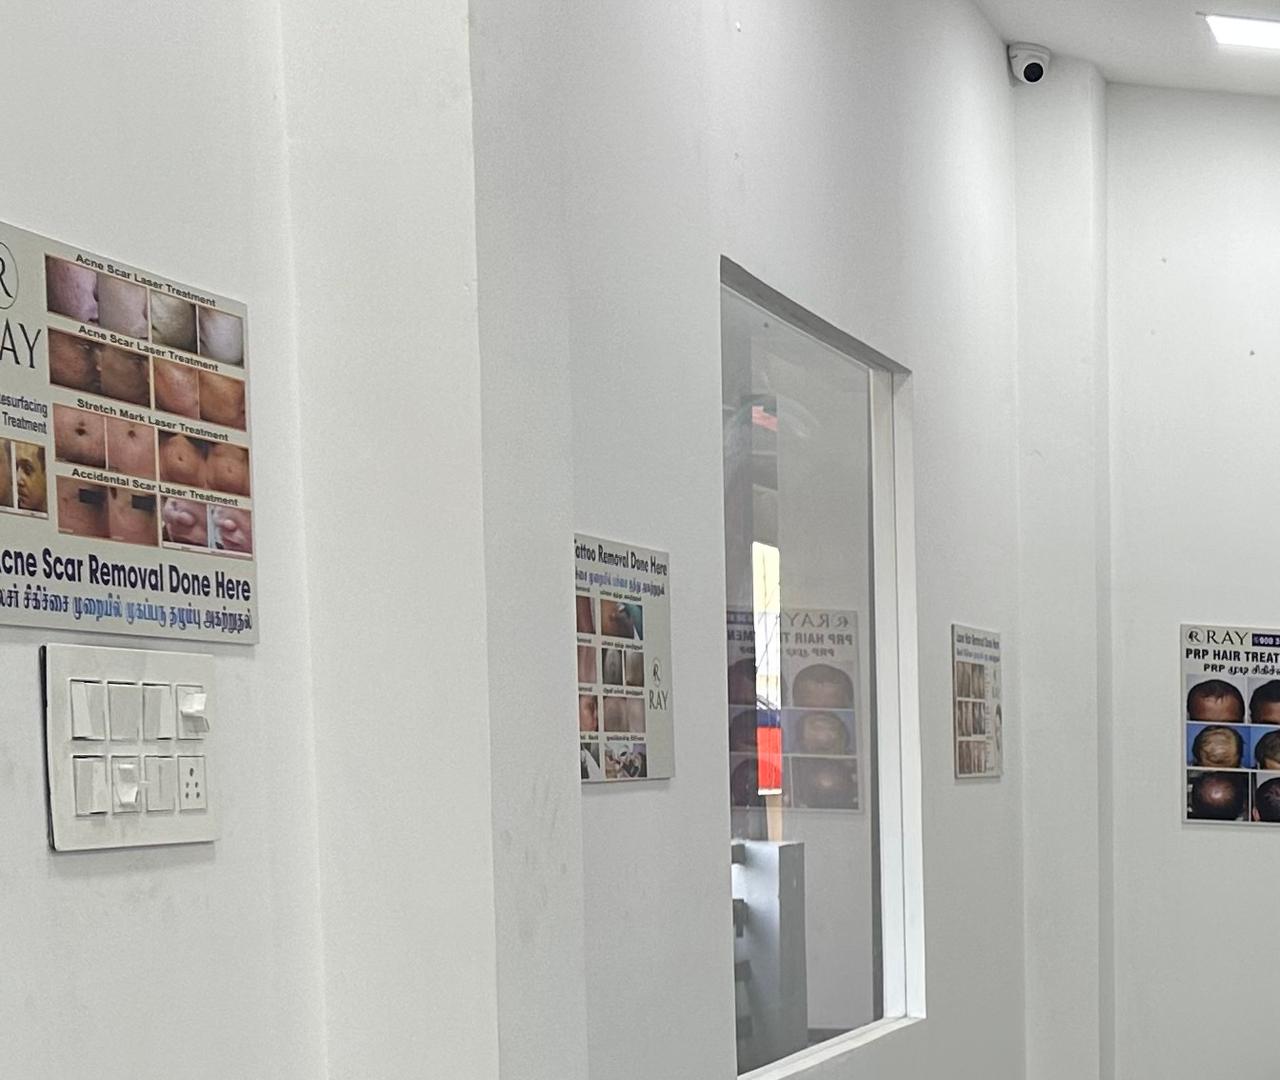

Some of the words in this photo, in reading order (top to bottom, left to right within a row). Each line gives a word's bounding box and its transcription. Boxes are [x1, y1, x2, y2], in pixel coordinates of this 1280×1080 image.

[76, 254, 103, 270] Acne
[107, 263, 131, 279] Scar
[134, 270, 162, 290] Laser
[165, 282, 216, 307] Treatment
[0, 318, 41, 369] AY
[78, 325, 107, 341] Acne
[110, 334, 134, 348] Scar
[137, 341, 165, 358] Laser
[168, 350, 219, 372] Treatment
[0, 394, 48, 418] esurfacing
[2, 411, 47, 434] Treatment
[77, 398, 117, 416] Stretch
[120, 409, 145, 422] Mark
[148, 416, 177, 429] Laser
[179, 423, 229, 441] Treatment
[71, 468, 130, 487] Accidental
[132, 479, 156, 491] Scar
[159, 484, 187, 496] Laser
[190, 490, 238, 506] Treatment
[0, 549, 37, 577] cne
[42, 548, 84, 583] Scar
[89, 554, 164, 592] Removal
[168, 565, 211, 596] Done
[215, 571, 251, 601] Here
[574, 541, 596, 562] attoo
[598, 544, 629, 568] Removal
[631, 552, 648, 573] Done
[650, 555, 667, 576] Here
[1185, 648, 1209, 660] PRP
[1213, 649, 1240, 662] HAIR
[1207, 630, 1248, 645] RAY
[1203, 663, 1225, 672] PRP
[649, 690, 669, 710] RAY
